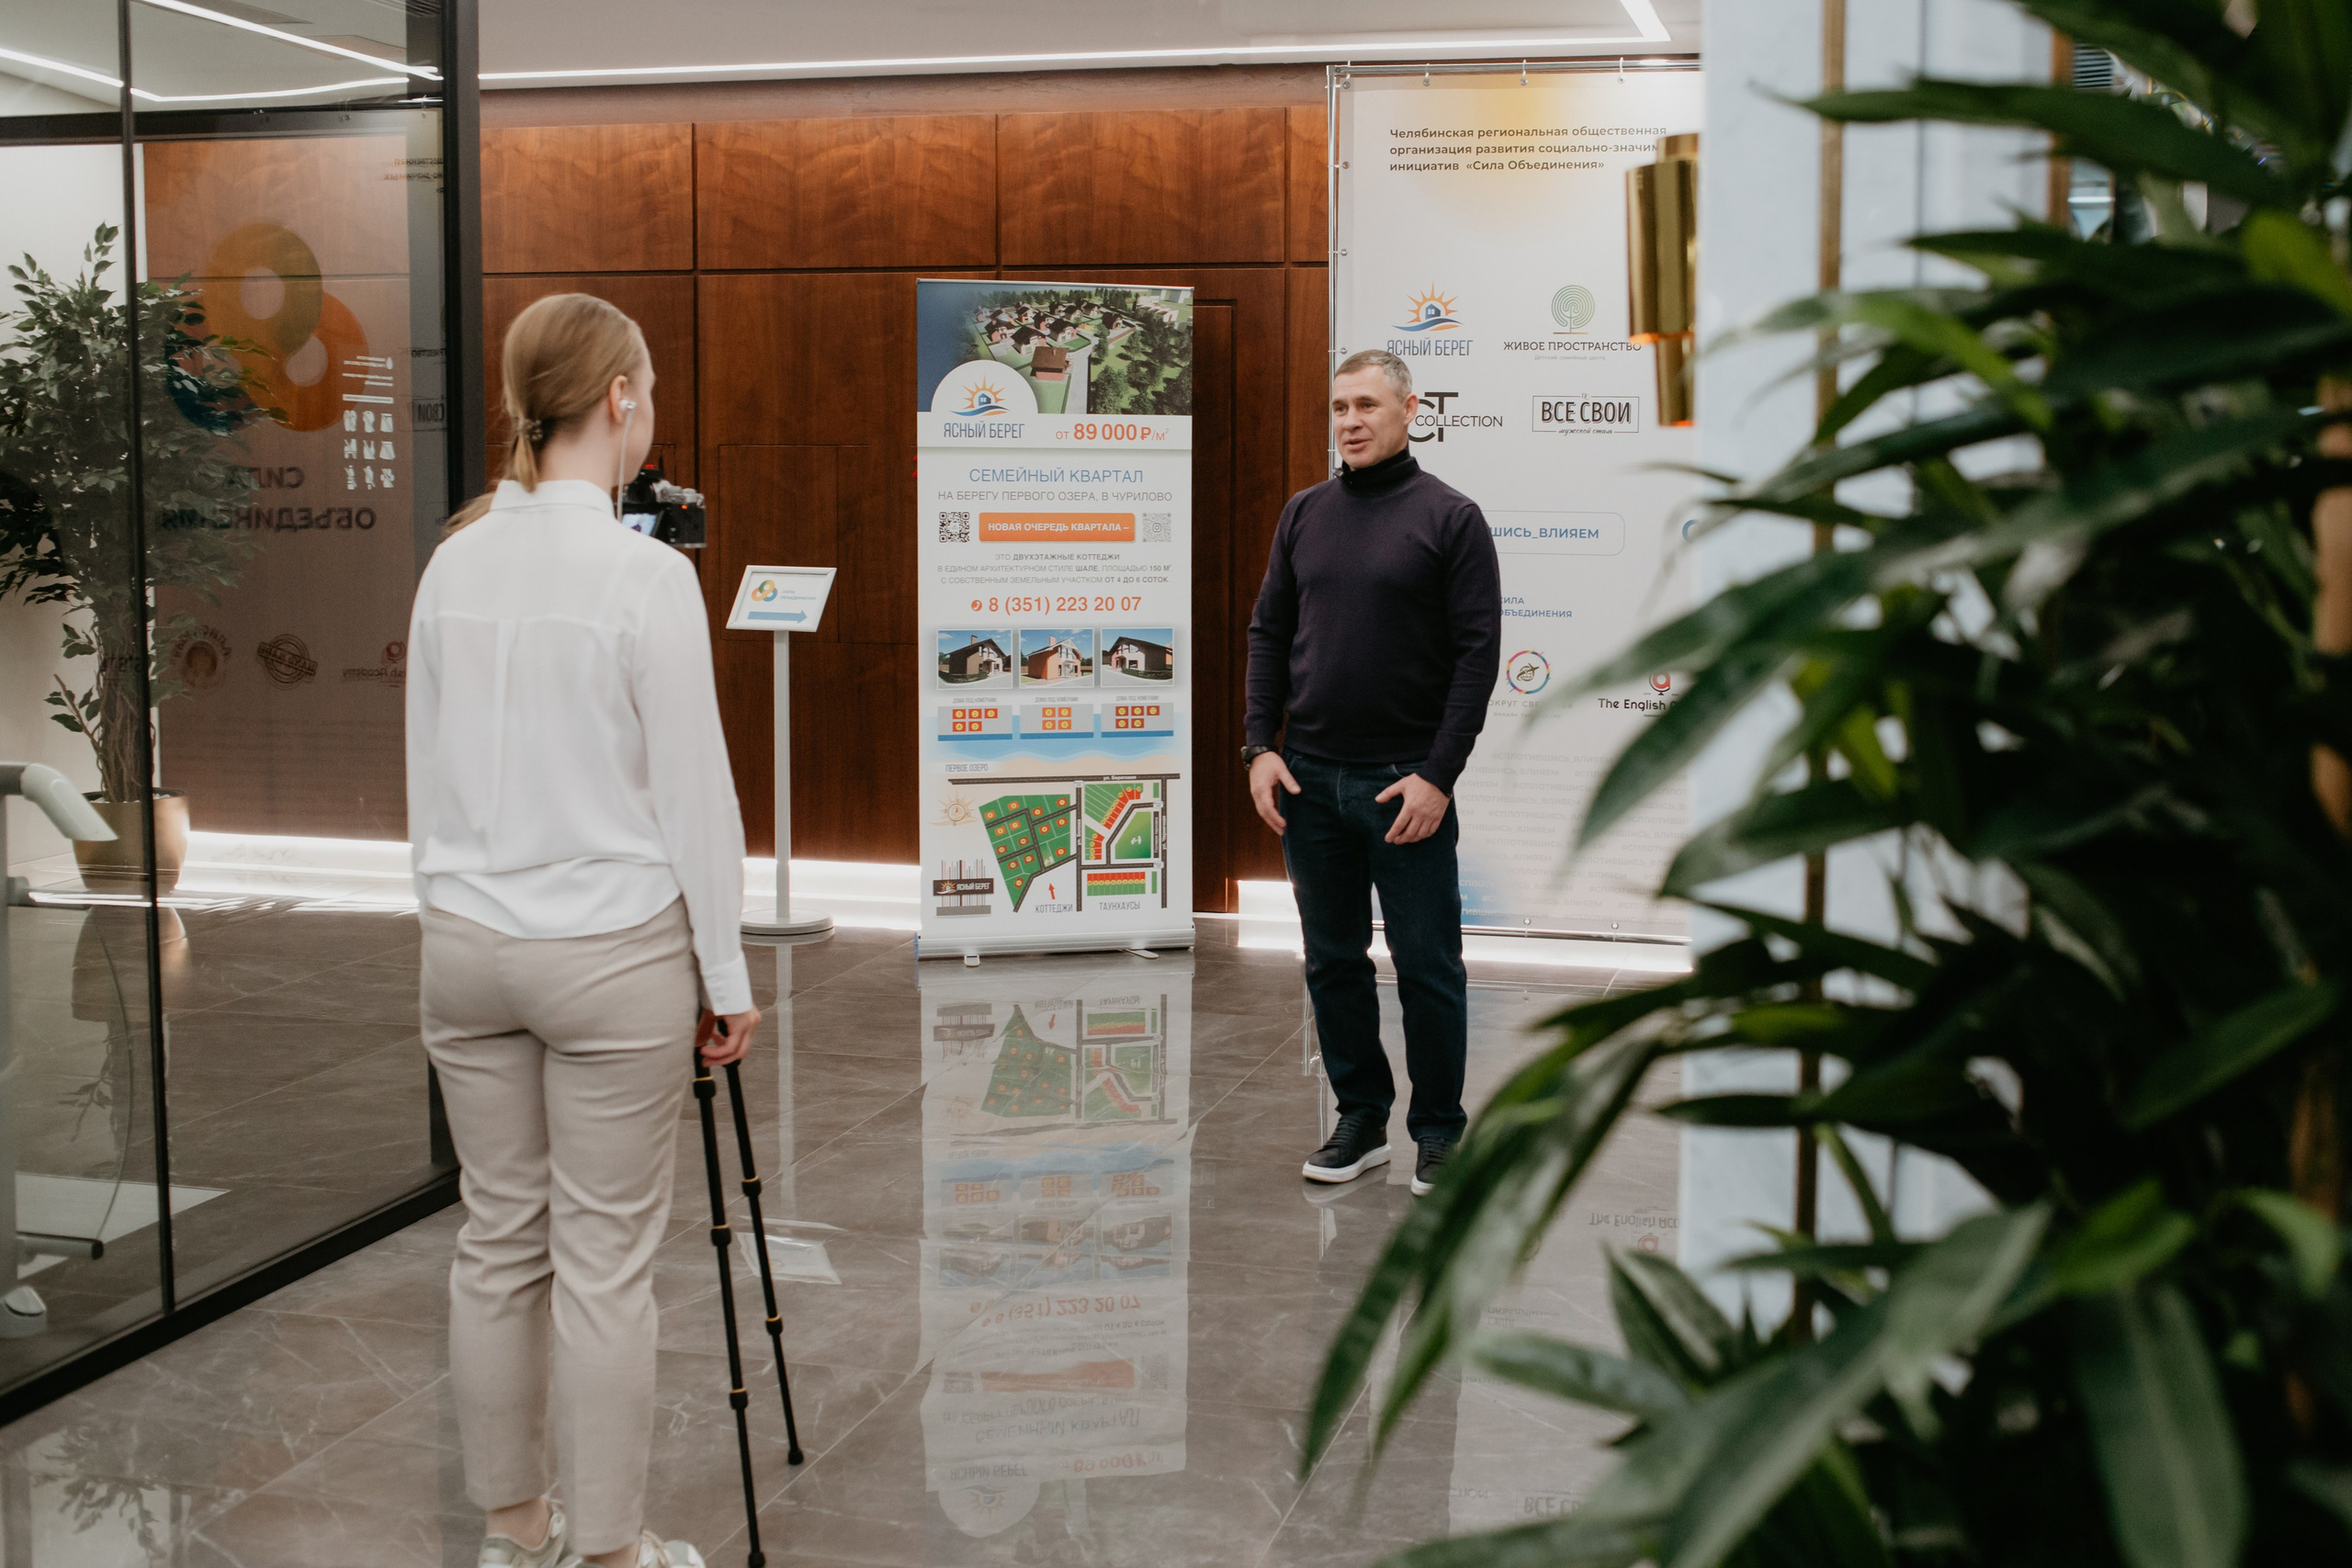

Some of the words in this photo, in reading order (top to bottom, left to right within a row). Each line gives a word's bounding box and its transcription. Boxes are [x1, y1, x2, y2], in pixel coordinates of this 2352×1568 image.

[1390, 128, 1474, 138] Челябинская
[1477, 128, 1568, 139] региональная
[1572, 126, 1667, 136] общественная
[1390, 146, 1472, 156] организация
[1476, 145, 1534, 155] развития
[1538, 143, 1657, 153] социально-значим
[1390, 163, 1459, 172] инициатив
[1466, 161, 1504, 170] «Сила
[1508, 160, 1604, 171] Объединения»
[1386, 337, 1431, 355] ЯСНЫЙ
[1435, 340, 1474, 355] БЕРЕГ
[1503, 342, 1544, 351] ЖИВОЕ
[1548, 342, 1642, 351] ПРОСТРАНСТВО
[1542, 401, 1577, 423] ВСЕ
[1580, 401, 1631, 424] СВОИ
[1415, 415, 1503, 427] COLLECTION
[944, 422, 987, 438] ЯСНЫЙ
[989, 423, 1025, 439] БЕРЕГ
[1073, 423, 1097, 441] 89
[1102, 423, 1137, 441] 000
[969, 467, 1065, 482] СЕМЕЙНЫЙ
[1069, 469, 1143, 483] КВАРТАЛ
[938, 491, 954, 501] НА
[956, 491, 998, 502] БЕРЕГУ
[1001, 491, 1055, 501] ПЕРВОГО
[1057, 491, 1098, 502] ОЗЕРА,
[1102, 492, 1108, 502] В
[1112, 492, 1172, 502] ЧУРИЛОВО
[988, 523, 1022, 532] НОВАЯ
[1024, 523, 1069, 533] ОЧЕРЕДЬ
[1071, 523, 1122, 532] КВАРТАЛА
[1489, 527, 1599, 539] ШИСЬ_ВЛИЯЕМ
[1012, 553, 1075, 561] ДВУХЭТАЖНЫЕ
[988, 597, 999, 612] 8
[1004, 597, 1050, 615] (351)
[1057, 597, 1088, 612] 223
[1093, 597, 1115, 612] 20
[1121, 597, 1142, 611] 07
[1598, 698, 1620, 708] The
[1623, 699, 1667, 711] English
[945, 763, 968, 772] ПЕРВОЕ
[969, 763, 989, 772] ОЗЕРО
[956, 883, 975, 891] ЯСНЫЙ
[1035, 904, 1073, 914] КОТТЕДЖИ
[1099, 901, 1140, 911] ТАУНХАУСЫ
